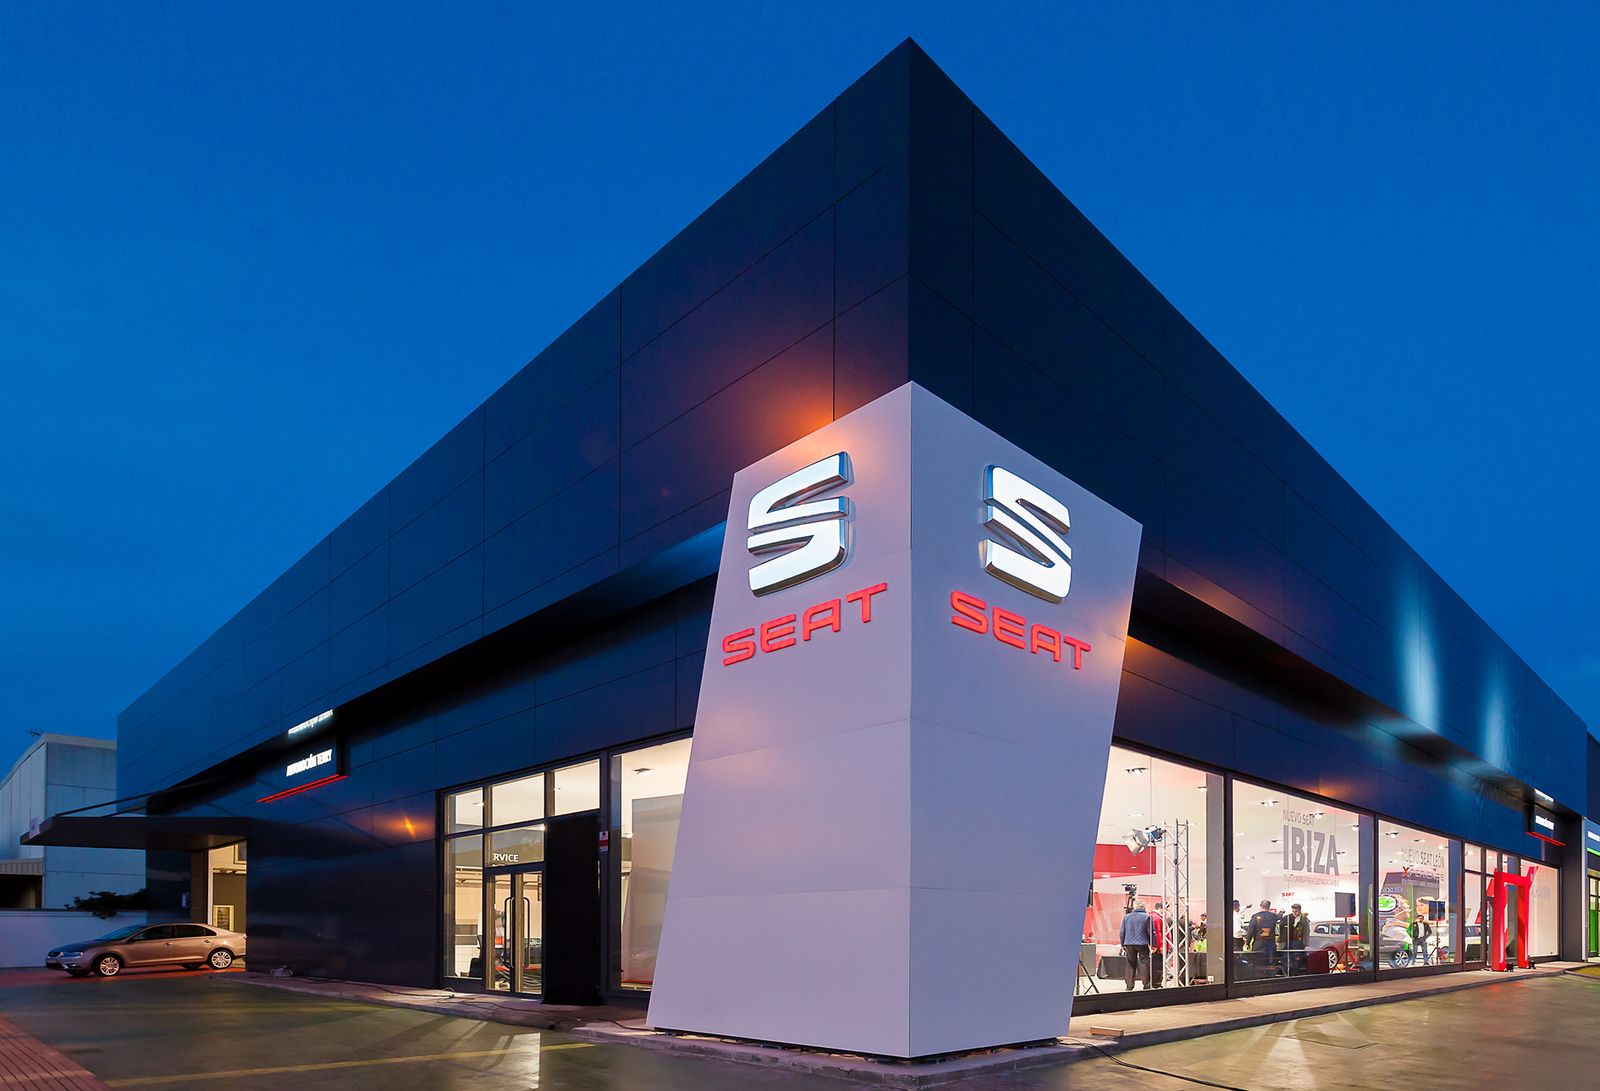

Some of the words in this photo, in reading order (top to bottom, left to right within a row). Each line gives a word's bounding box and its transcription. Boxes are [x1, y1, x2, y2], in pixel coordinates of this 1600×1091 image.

[722, 582, 888, 667] SEAT
[950, 590, 1092, 671] SEAT
[492, 852, 519, 862] RVICE
[1283, 825, 1340, 876] IBIZA
